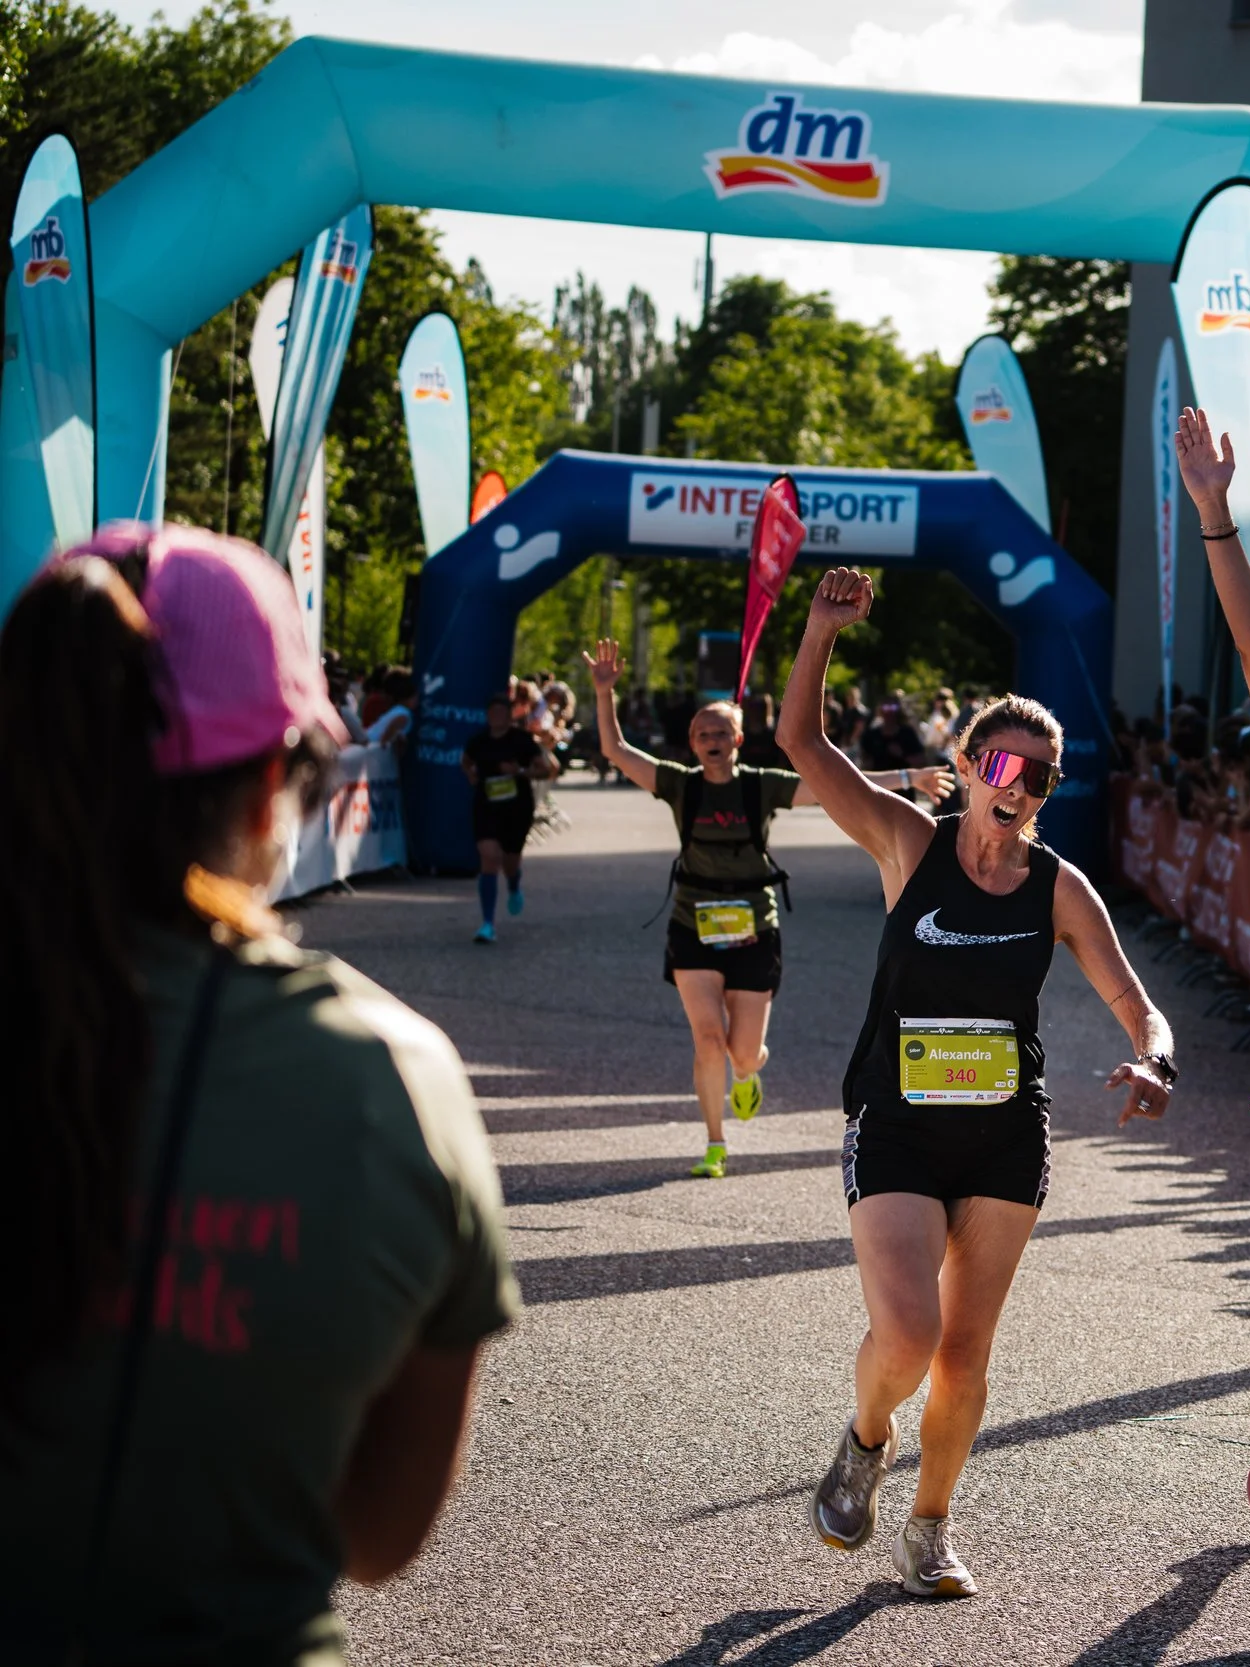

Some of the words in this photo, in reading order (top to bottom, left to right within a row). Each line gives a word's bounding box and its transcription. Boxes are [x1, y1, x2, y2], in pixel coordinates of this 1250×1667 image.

[746, 95, 864, 160] dm
[679, 483, 905, 524] INTESPORT
[929, 1048, 991, 1060] Alexandra
[944, 1068, 977, 1083] 340
